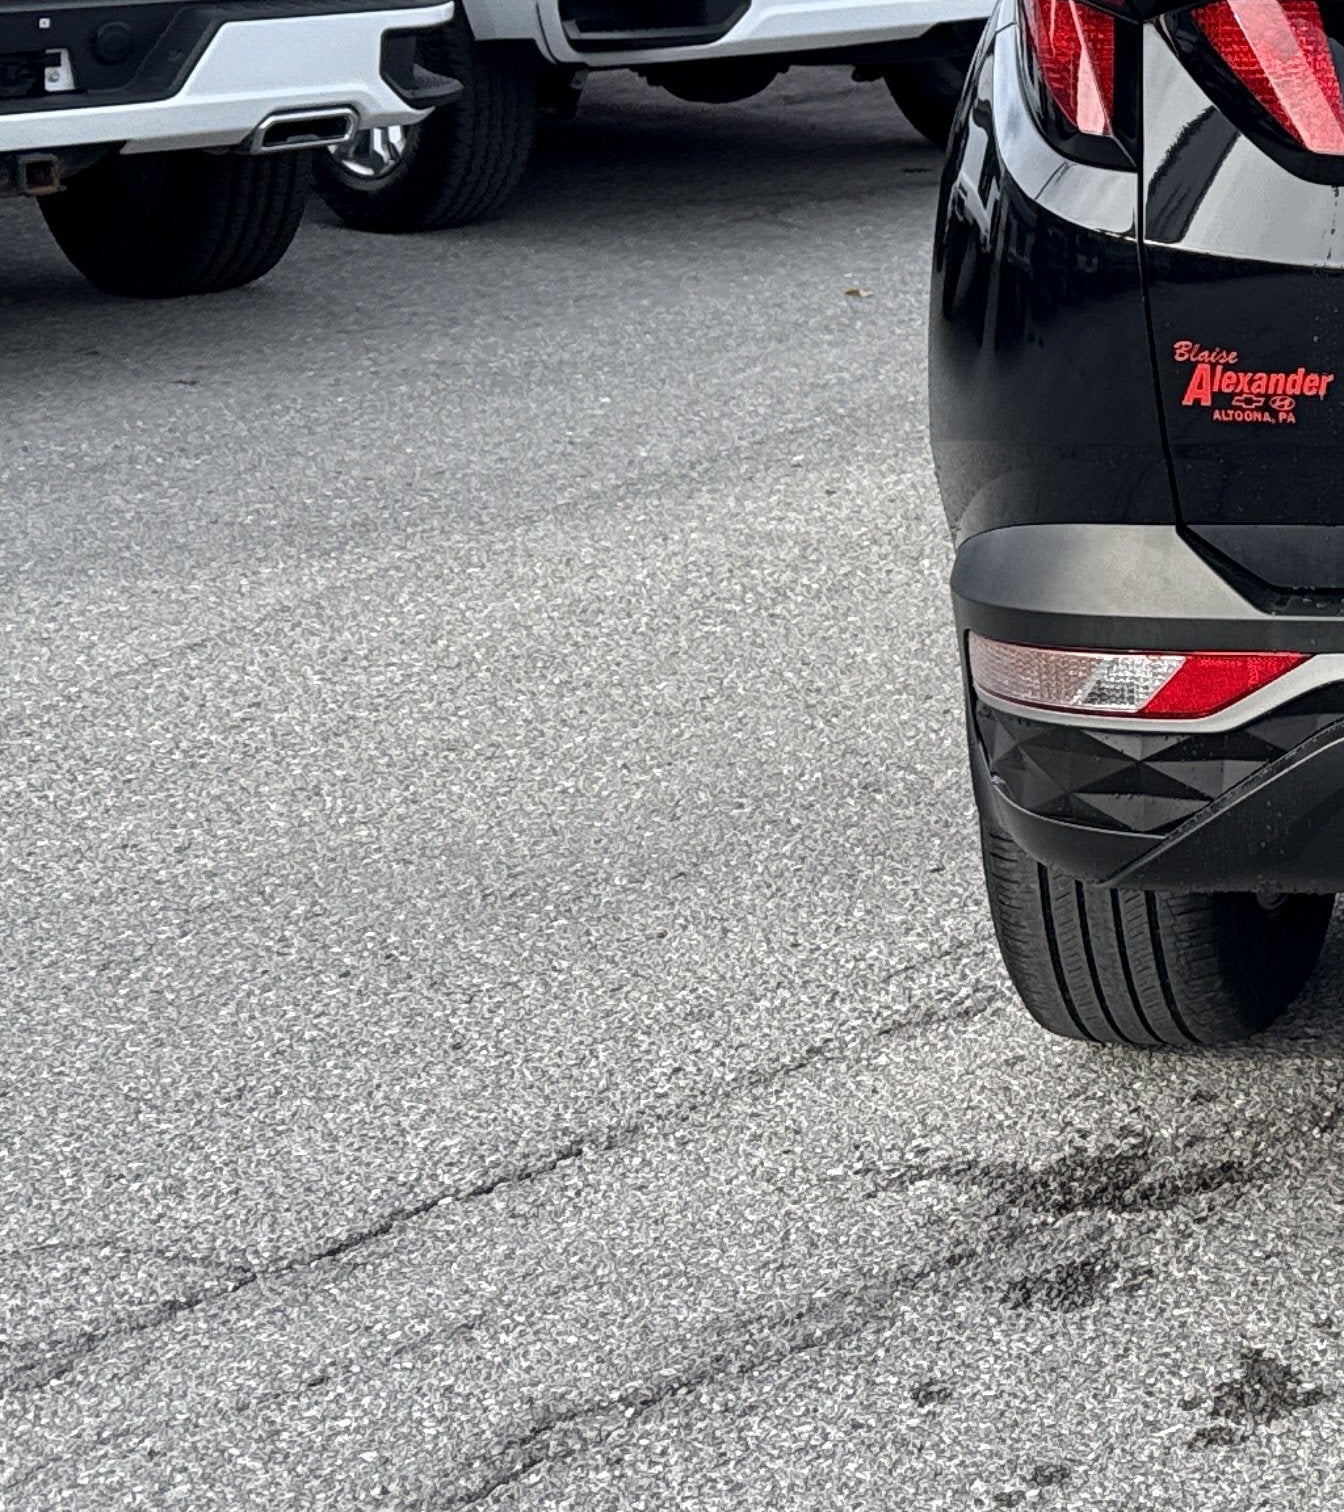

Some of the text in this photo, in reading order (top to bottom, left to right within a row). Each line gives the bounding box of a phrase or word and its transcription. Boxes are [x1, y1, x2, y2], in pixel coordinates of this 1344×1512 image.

[1172, 340, 1239, 365] Blaise
[1181, 362, 1335, 407] Alexander
[1212, 409, 1296, 424] ALTOONA, PA
